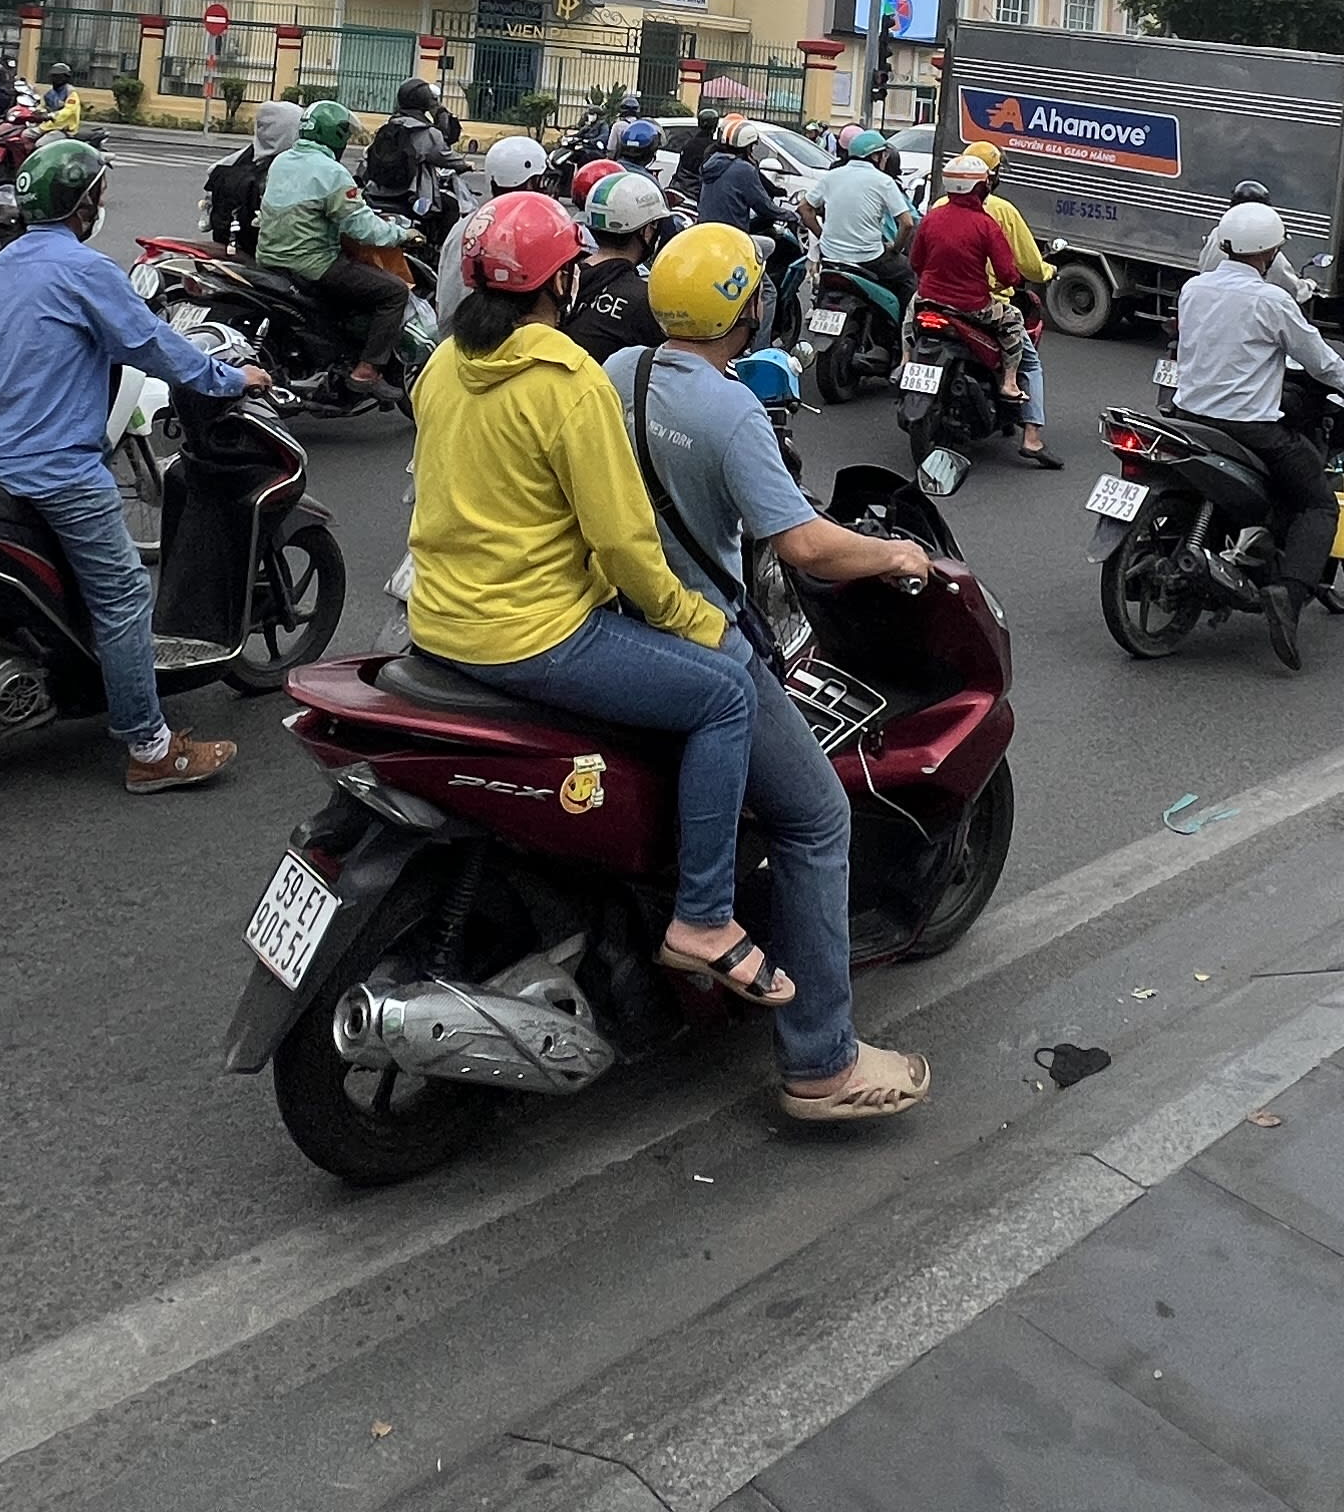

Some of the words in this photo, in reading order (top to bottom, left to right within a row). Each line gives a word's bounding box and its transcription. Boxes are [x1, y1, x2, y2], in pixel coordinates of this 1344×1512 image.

[1028, 106, 1146, 146] Ahamove
[1046, 145, 1063, 154] GIA
[1064, 147, 1089, 157] GIAO
[648, 420, 666, 437] NEW
[667, 428, 694, 449] YORK
[448, 774, 555, 801] PCX
[250, 902, 311, 982] 905.54
